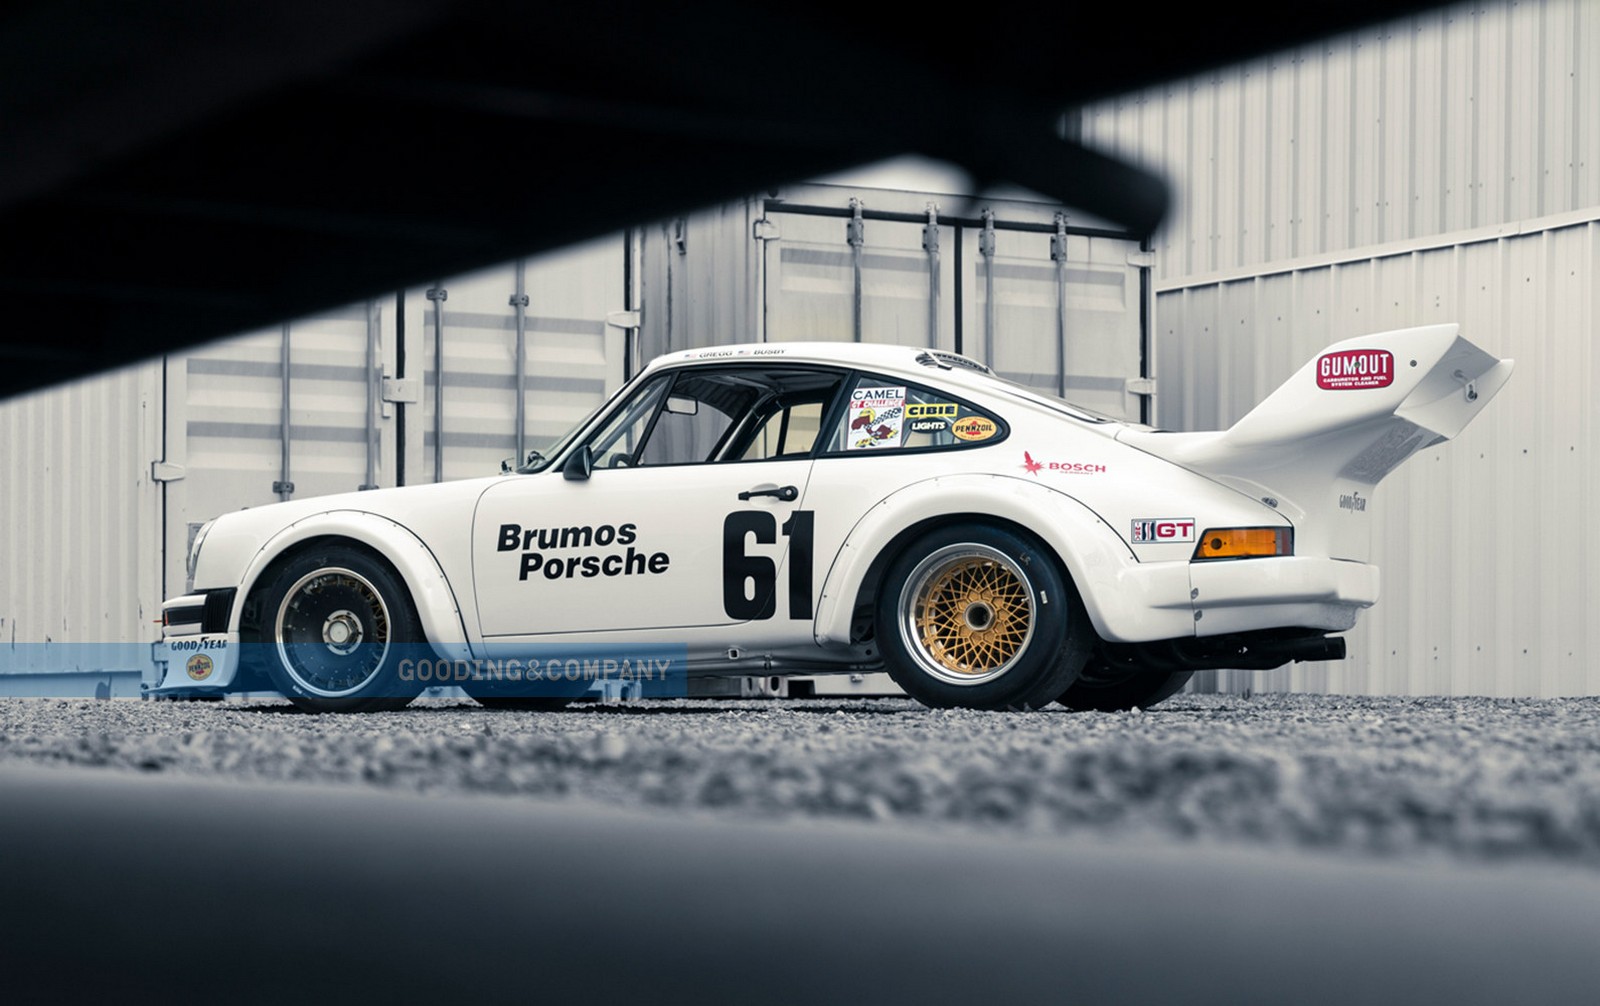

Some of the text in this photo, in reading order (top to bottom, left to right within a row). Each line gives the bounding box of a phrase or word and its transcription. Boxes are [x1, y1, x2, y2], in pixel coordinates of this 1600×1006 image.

[1321, 353, 1389, 377] GUMOUT
[853, 389, 904, 400] CAMEL
[908, 405, 956, 416] CIBIE
[911, 421, 946, 431] LIGHTS
[955, 424, 993, 433] PENNZOIL
[1049, 462, 1106, 473] BOSCH
[1156, 522, 1194, 538] GT
[497, 523, 637, 552] Brumos
[518, 547, 670, 581] Porsche
[723, 510, 815, 621] 61
